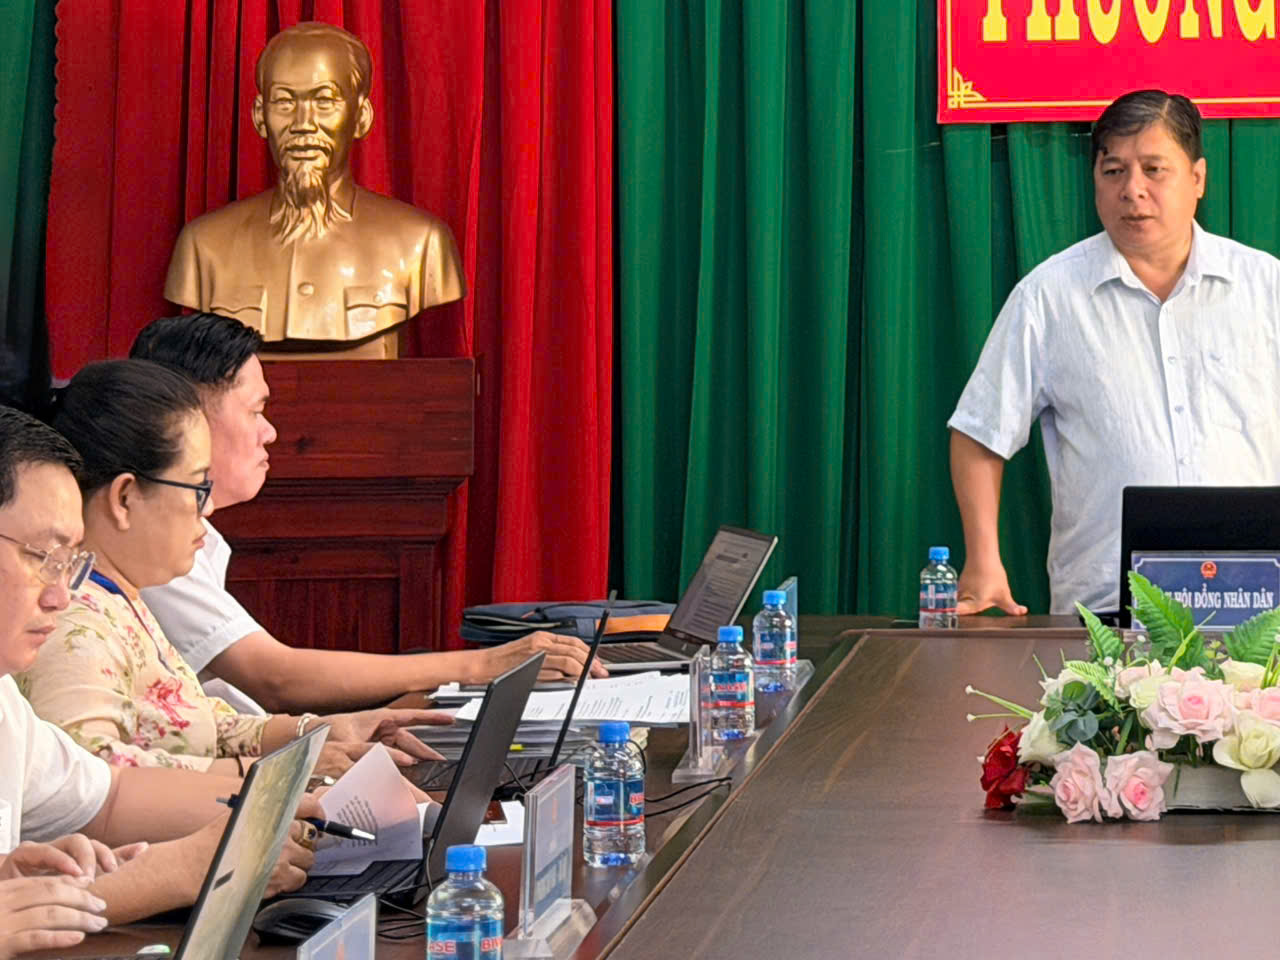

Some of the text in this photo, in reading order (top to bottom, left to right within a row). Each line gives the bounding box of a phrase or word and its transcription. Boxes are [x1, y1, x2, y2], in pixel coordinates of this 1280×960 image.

[1194, 583, 1222, 608] ĐỒNG
[1223, 587, 1251, 608] NHÂN
[1252, 587, 1274, 608] DÂN
